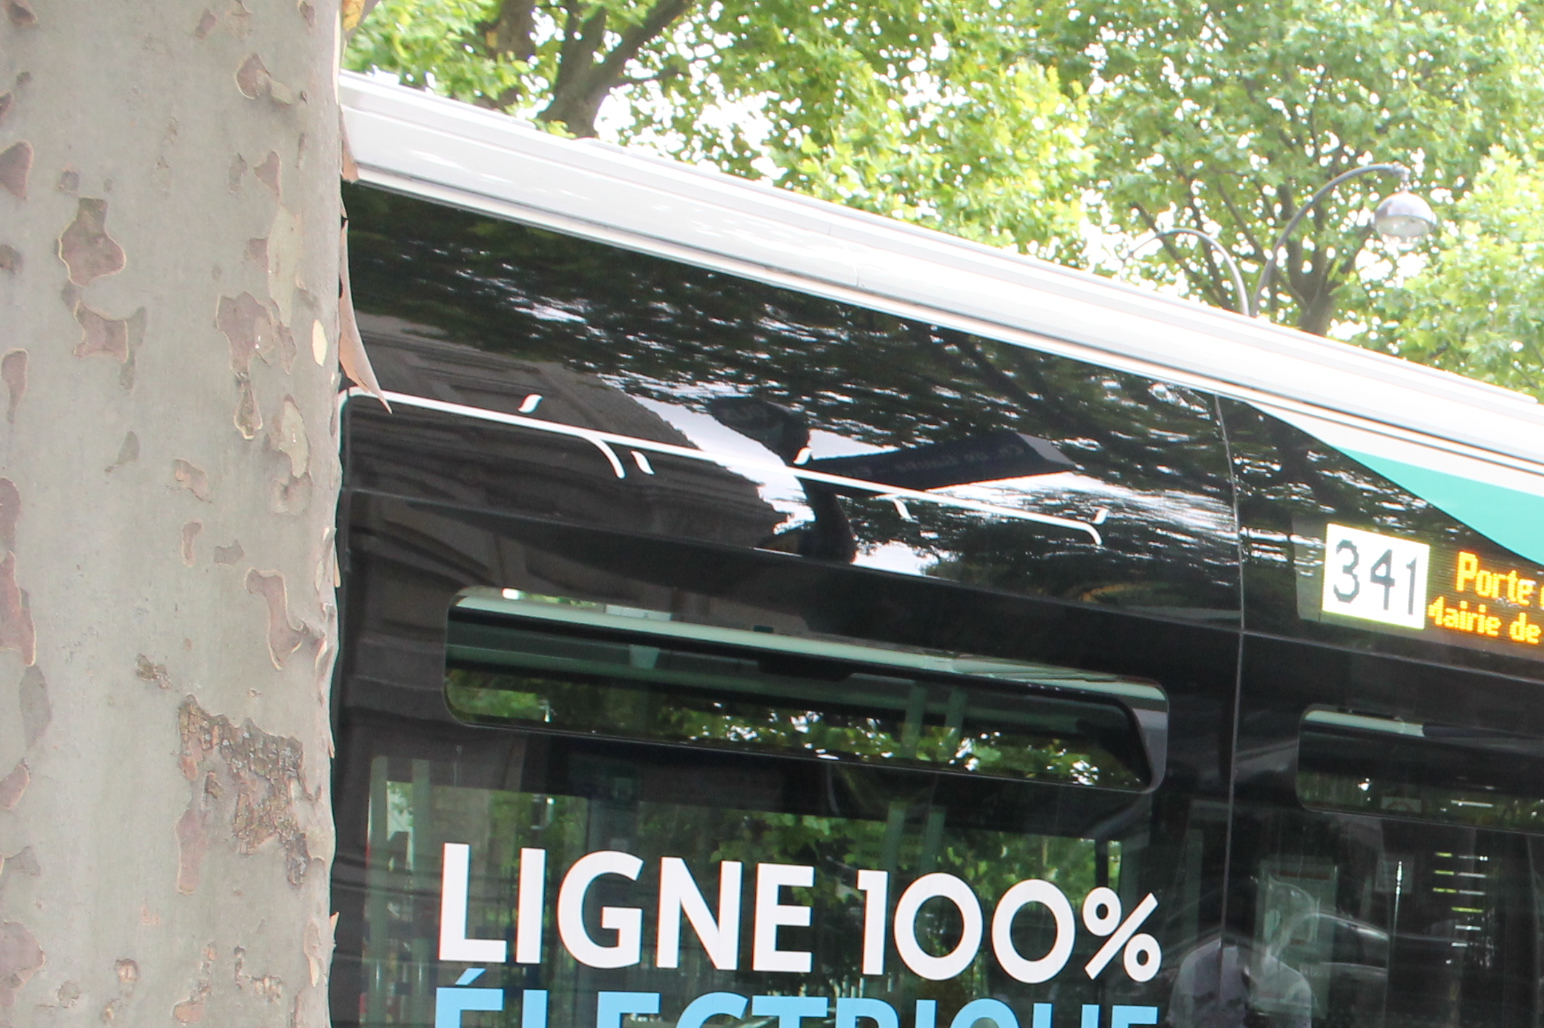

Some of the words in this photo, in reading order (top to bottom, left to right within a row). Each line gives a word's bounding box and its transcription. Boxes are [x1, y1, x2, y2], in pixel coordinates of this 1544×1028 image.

[1332, 538, 1419, 616] 341
[1456, 550, 1534, 607] Porte
[1509, 612, 1541, 644] de
[438, 842, 815, 974] LIGNE
[857, 868, 1163, 985] 100%
